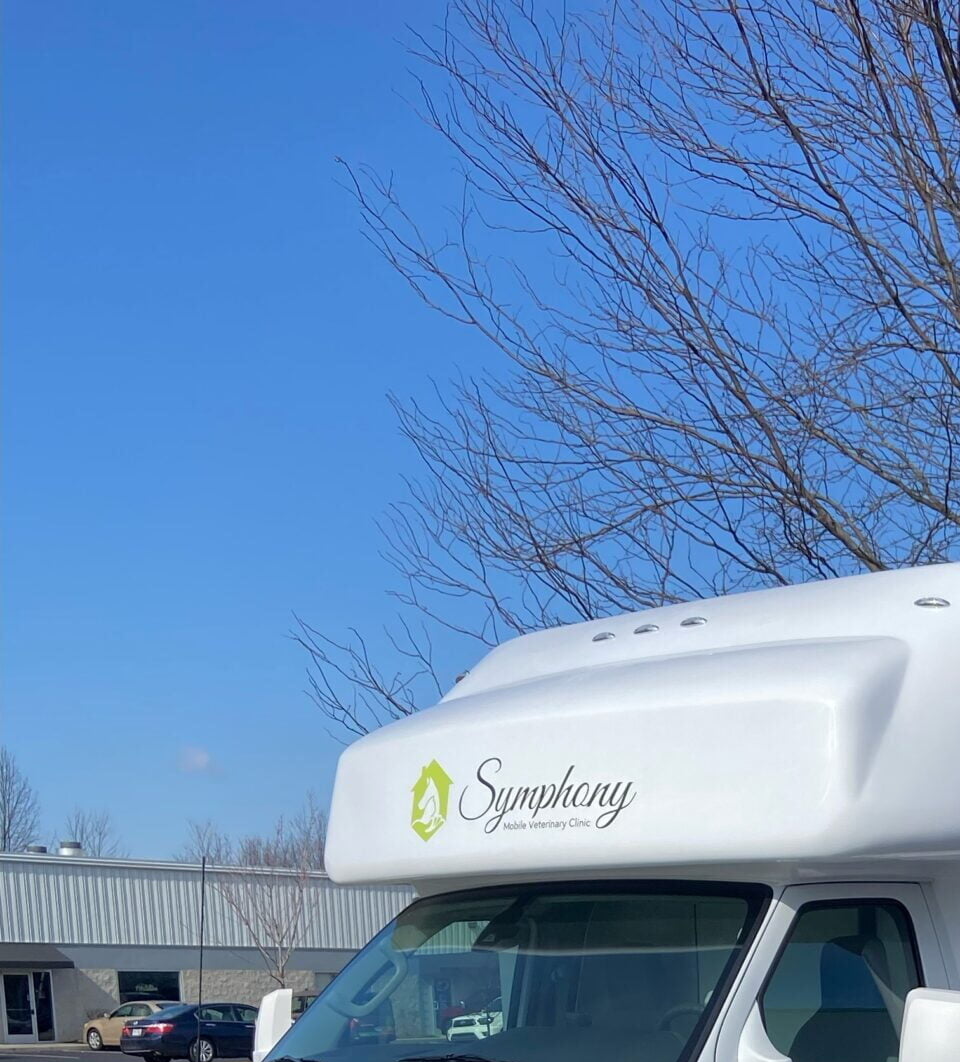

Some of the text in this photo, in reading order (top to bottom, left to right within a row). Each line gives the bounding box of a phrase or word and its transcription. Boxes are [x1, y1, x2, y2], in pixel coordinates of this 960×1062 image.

[458, 757, 638, 834] Symphony
[503, 817, 592, 831] Mobile Veterinary Clinic
